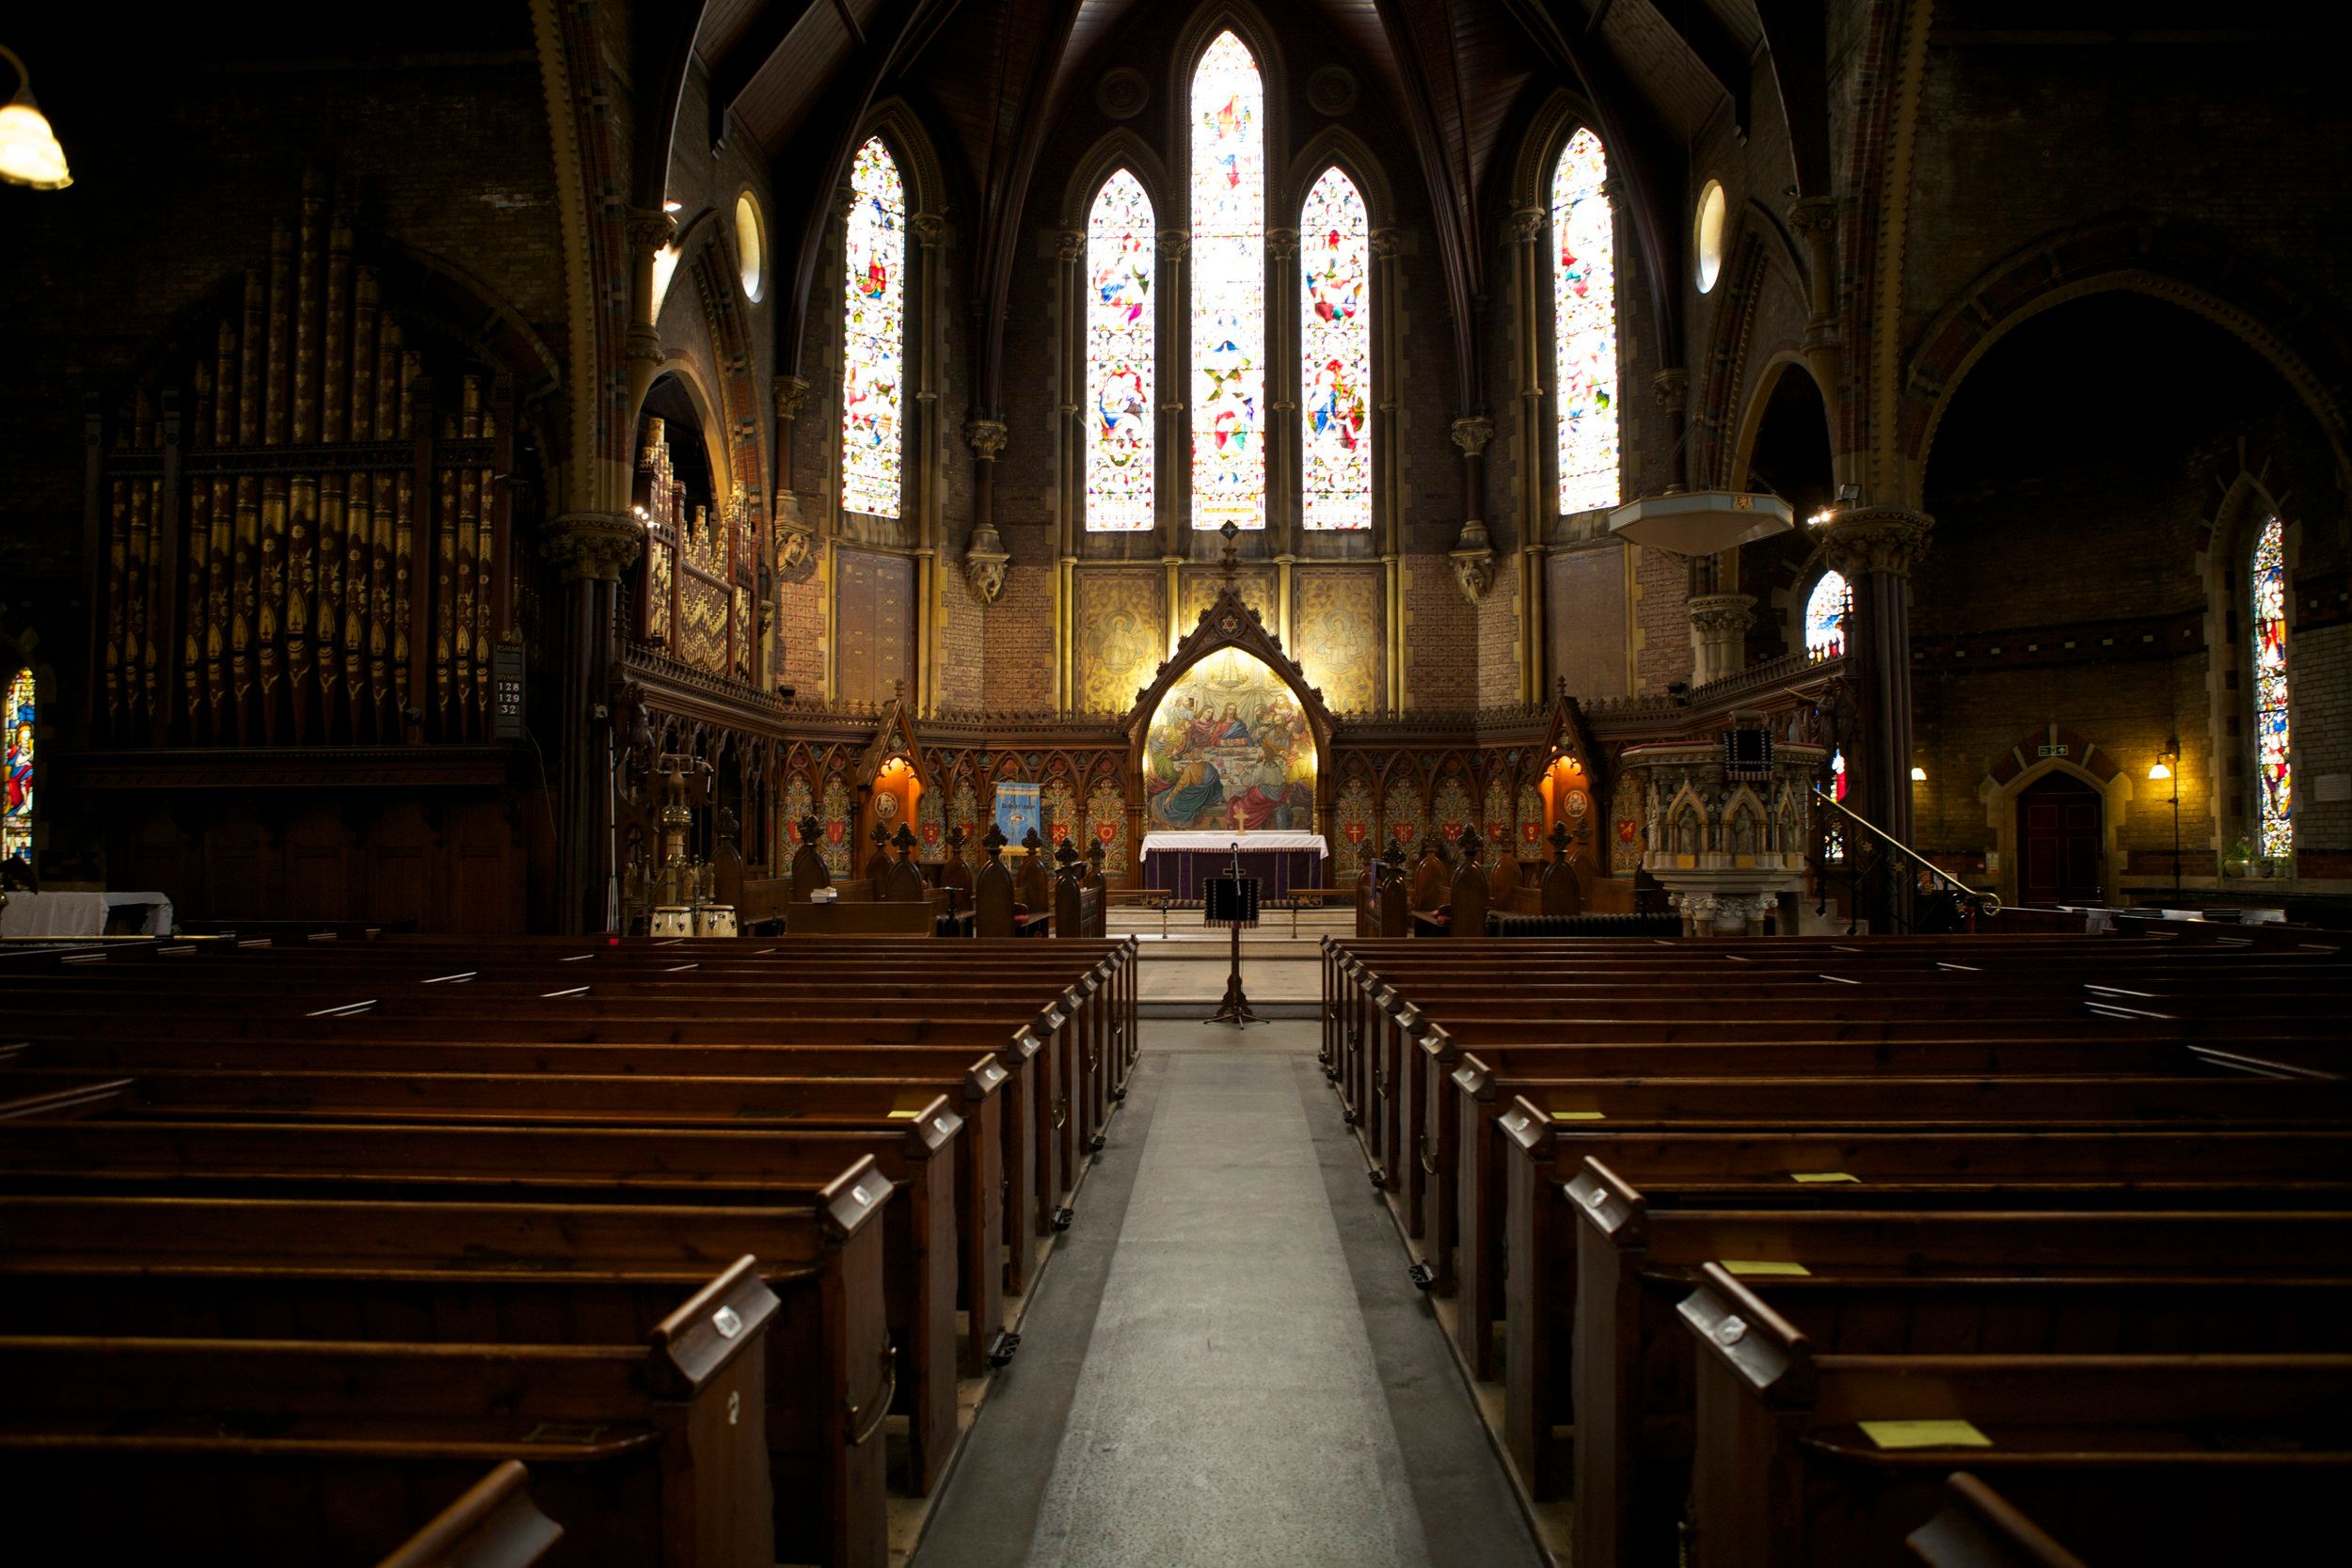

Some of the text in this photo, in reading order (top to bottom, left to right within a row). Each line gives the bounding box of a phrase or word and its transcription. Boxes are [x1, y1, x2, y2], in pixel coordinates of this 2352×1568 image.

[499, 682, 519, 691] 128
[499, 694, 520, 703] 129
[501, 705, 516, 715] 32
